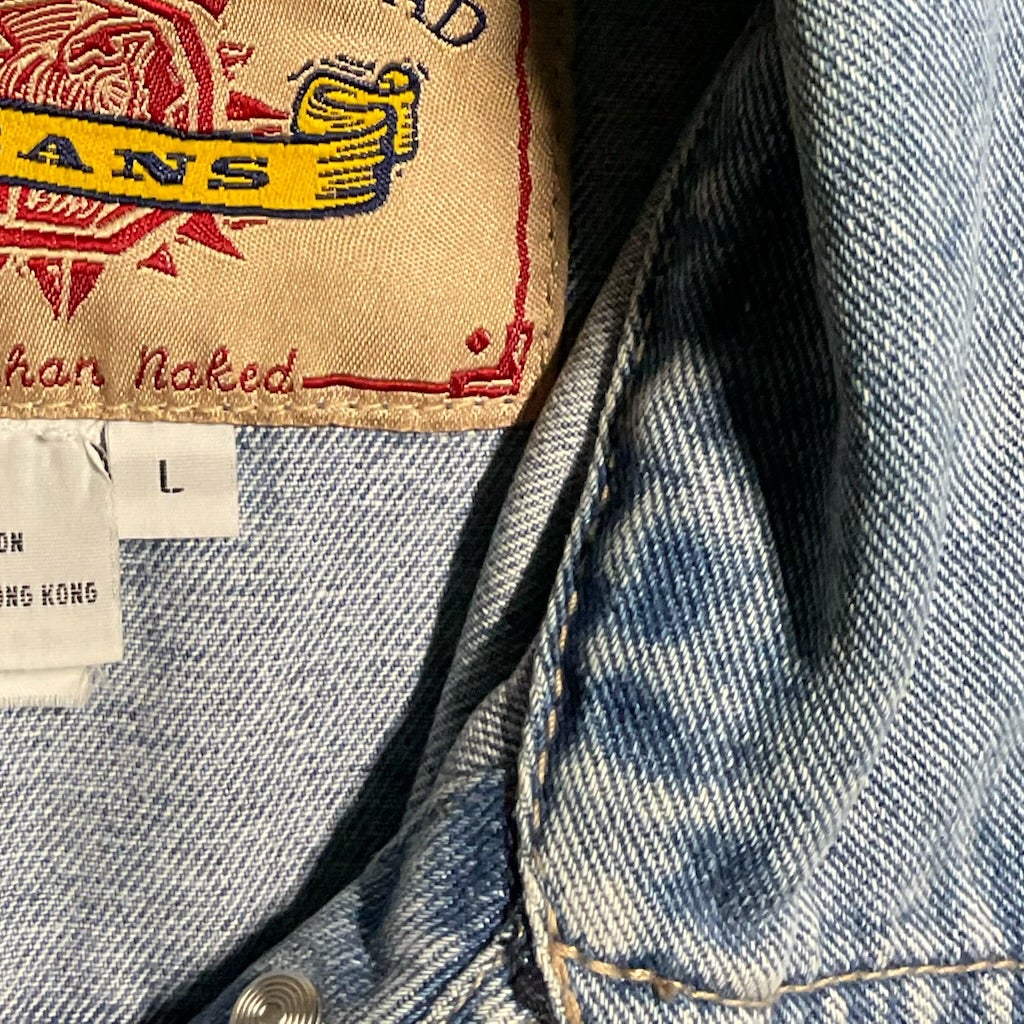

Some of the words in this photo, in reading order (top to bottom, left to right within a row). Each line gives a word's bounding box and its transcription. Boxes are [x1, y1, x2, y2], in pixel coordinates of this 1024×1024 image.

[134, 344, 298, 394] Naked
[159, 459, 185, 494] L
[41, 582, 98, 607] KONG
